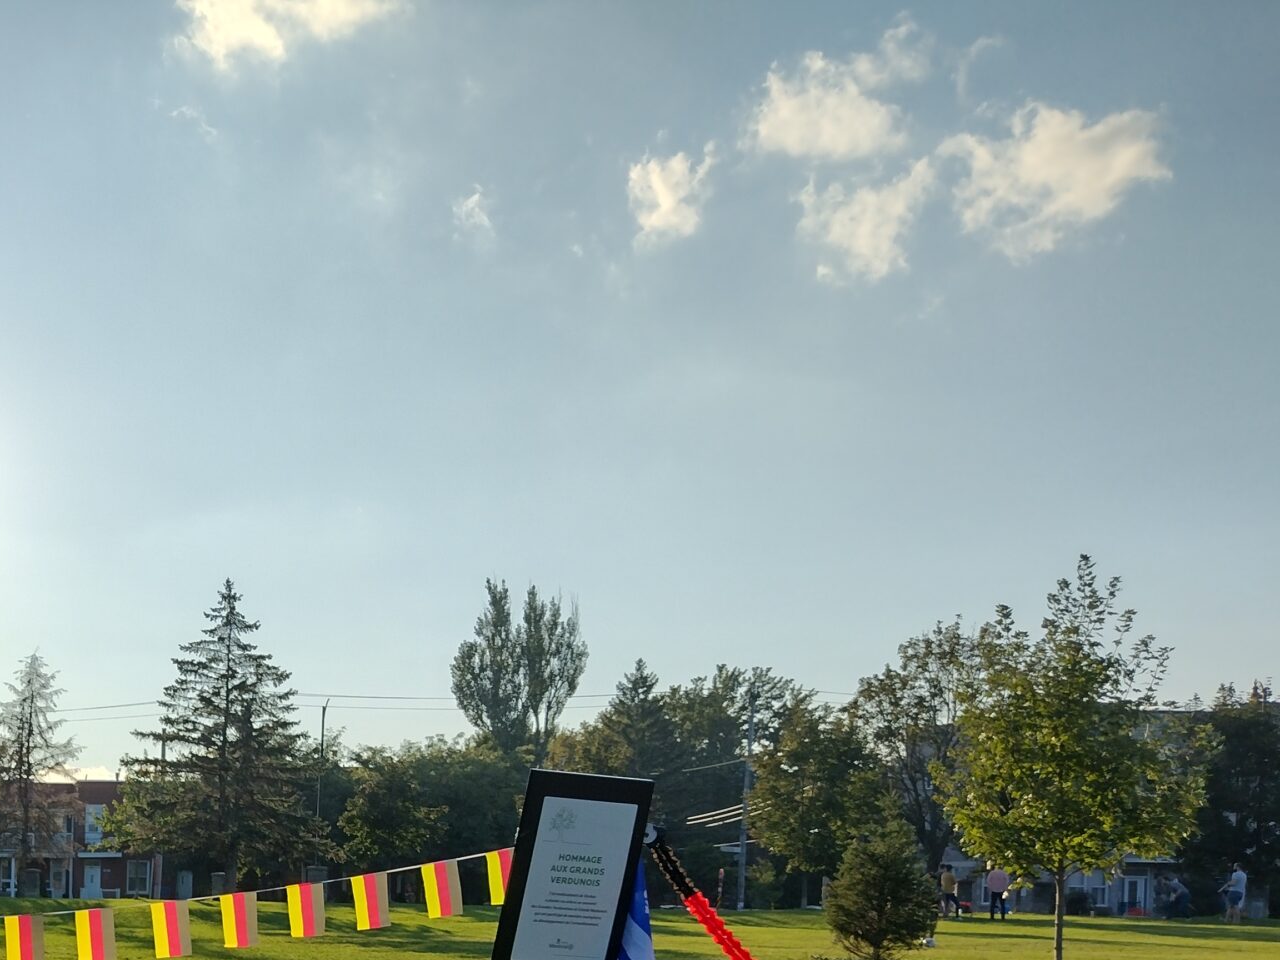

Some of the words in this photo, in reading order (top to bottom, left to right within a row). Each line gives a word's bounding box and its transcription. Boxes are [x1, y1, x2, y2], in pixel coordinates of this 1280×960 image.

[558, 853, 603, 864] HOMMAGE
[550, 865, 568, 873] AUX
[569, 866, 606, 876] GRANDS
[550, 876, 601, 887] VERDUNOIS
